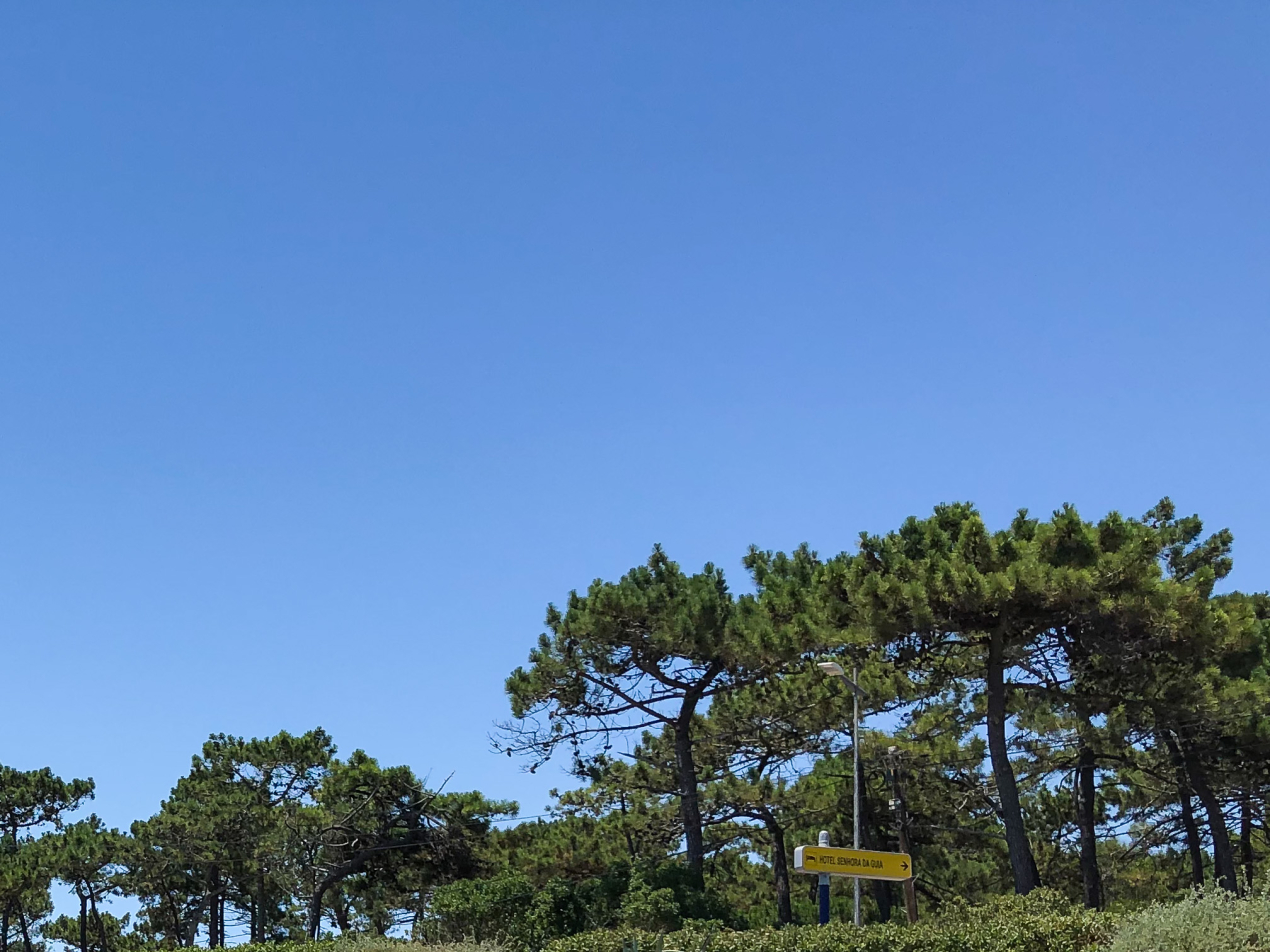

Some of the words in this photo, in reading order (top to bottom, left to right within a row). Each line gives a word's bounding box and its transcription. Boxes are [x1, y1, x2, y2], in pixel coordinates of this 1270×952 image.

[819, 855, 836, 865] HOTEL
[837, 856, 861, 867] SENHORA
[862, 858, 870, 867] DA
[871, 859, 884, 869] GUIA
